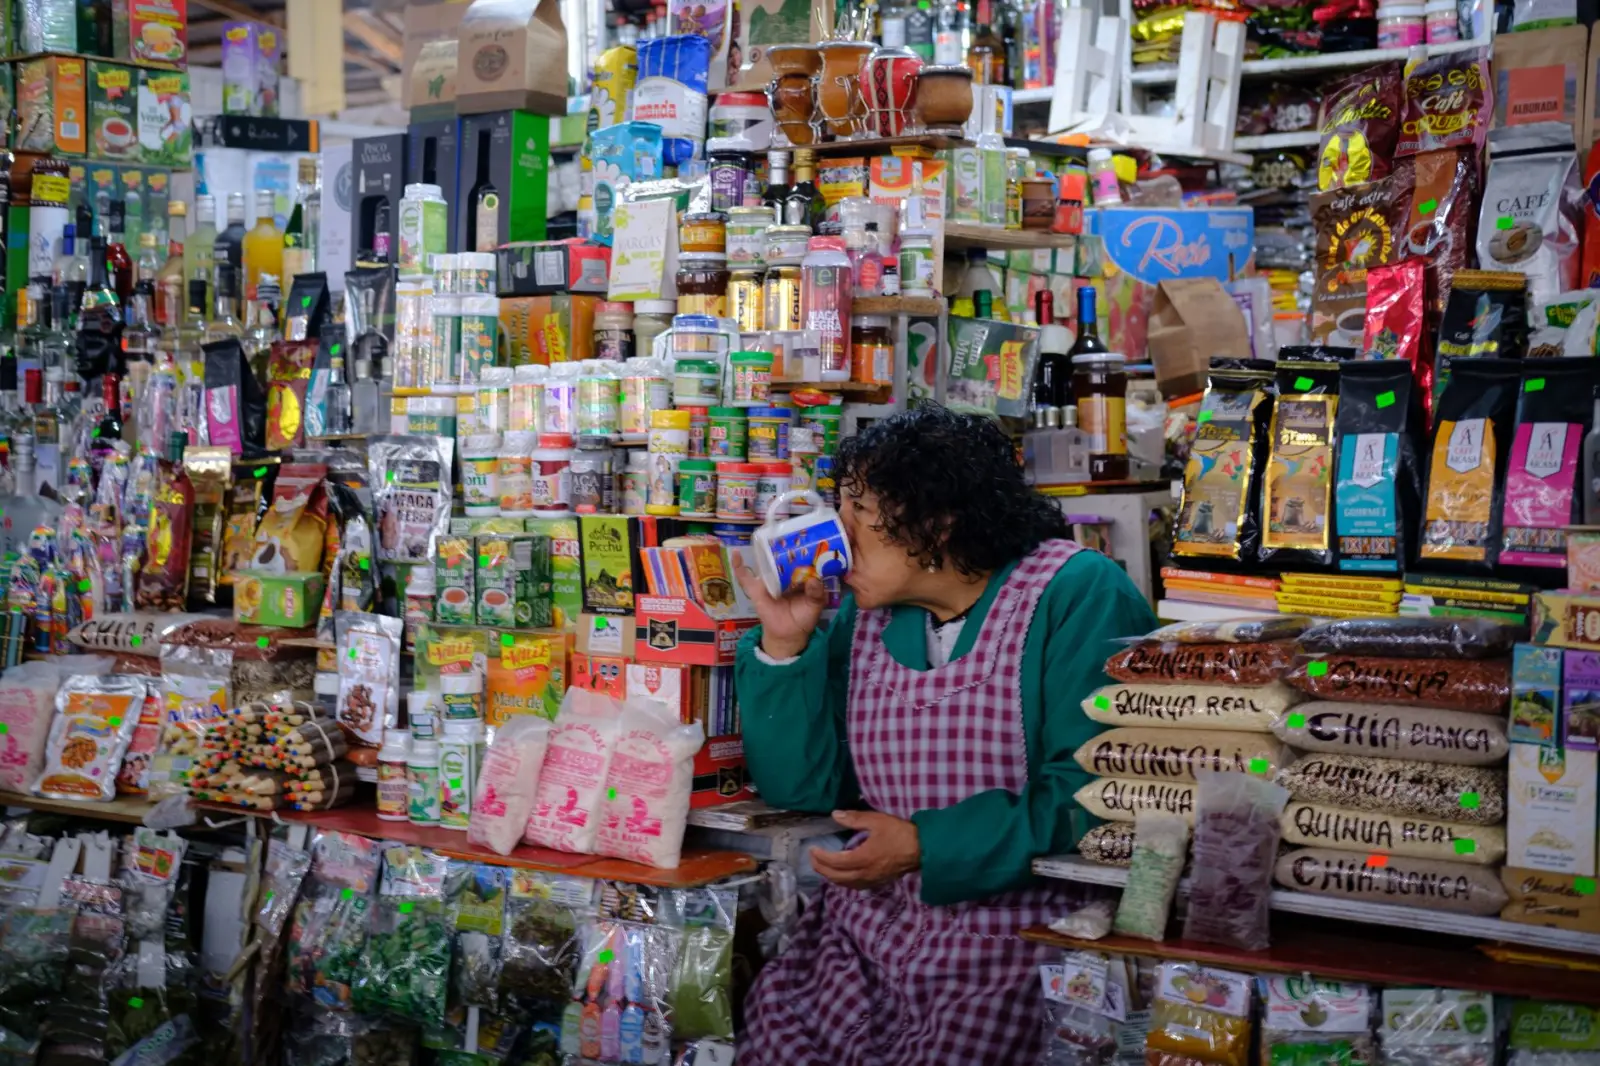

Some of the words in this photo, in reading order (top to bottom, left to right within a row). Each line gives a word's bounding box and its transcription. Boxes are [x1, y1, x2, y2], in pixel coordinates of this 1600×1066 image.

[1421, 91, 1465, 113] Café
[360, 152, 391, 164] VARGAS
[1497, 190, 1550, 213] CAFÉ
[806, 320, 842, 333] NEGRA
[589, 540, 623, 553] Picchu
[528, 693, 544, 709] de
[1115, 690, 1196, 721] QUINUA
[1207, 694, 1264, 715] REAL
[1410, 723, 1490, 752] BLANCA
[1101, 780, 1194, 817] QUINUA
[1294, 806, 1392, 849] QUINUA
[1402, 822, 1460, 843] REAL
